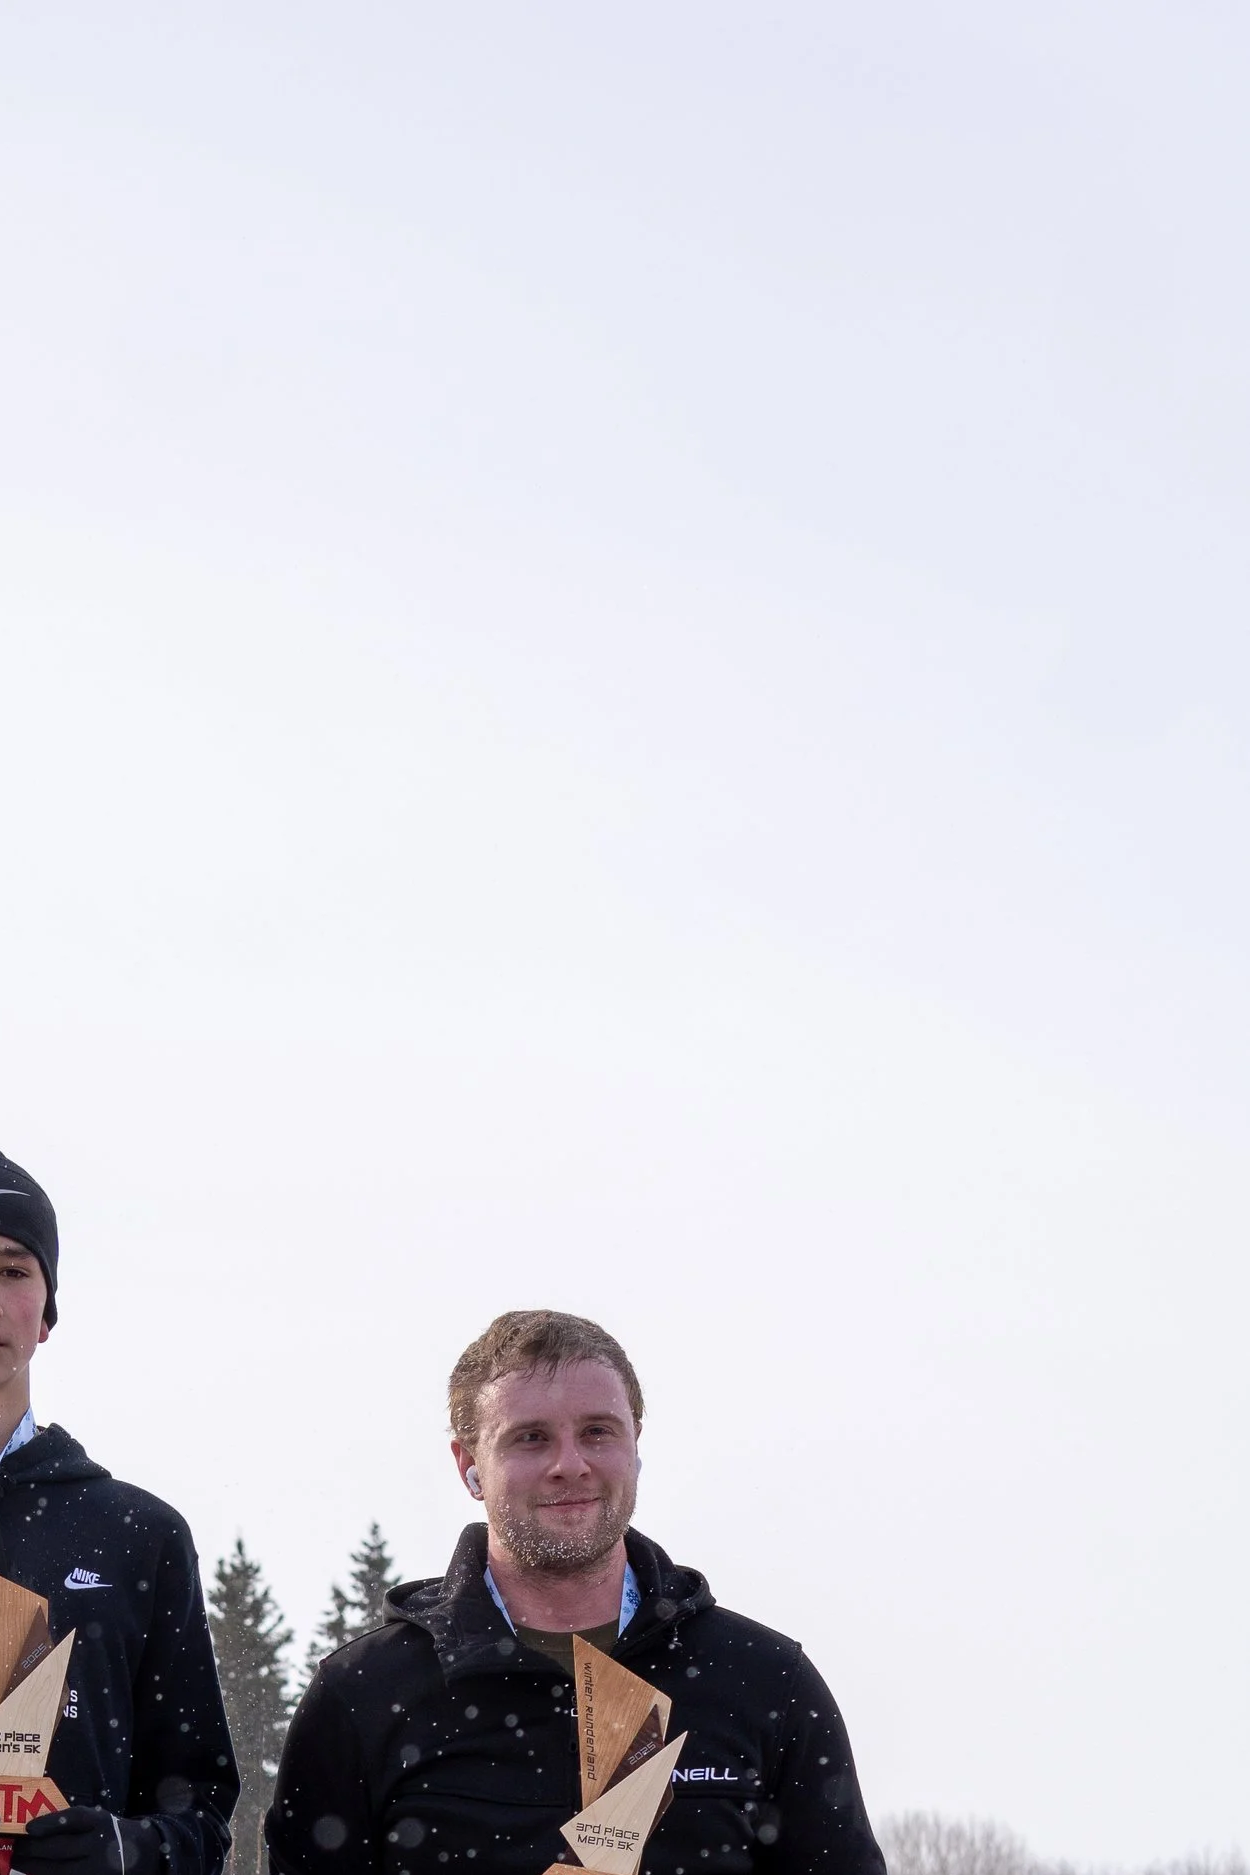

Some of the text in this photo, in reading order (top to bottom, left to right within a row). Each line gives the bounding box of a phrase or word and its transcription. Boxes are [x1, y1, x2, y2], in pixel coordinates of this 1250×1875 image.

[72, 1568, 100, 1584] NIKE
[22, 1643, 47, 1669] 2025
[4, 1731, 41, 1742] Place
[24, 1744, 41, 1754] 5K
[628, 1741, 656, 1766] 2025
[672, 1767, 738, 1782] NEILL
[576, 1822, 640, 1841] 3rd Place
[577, 1834, 635, 1851] Men's 5K
